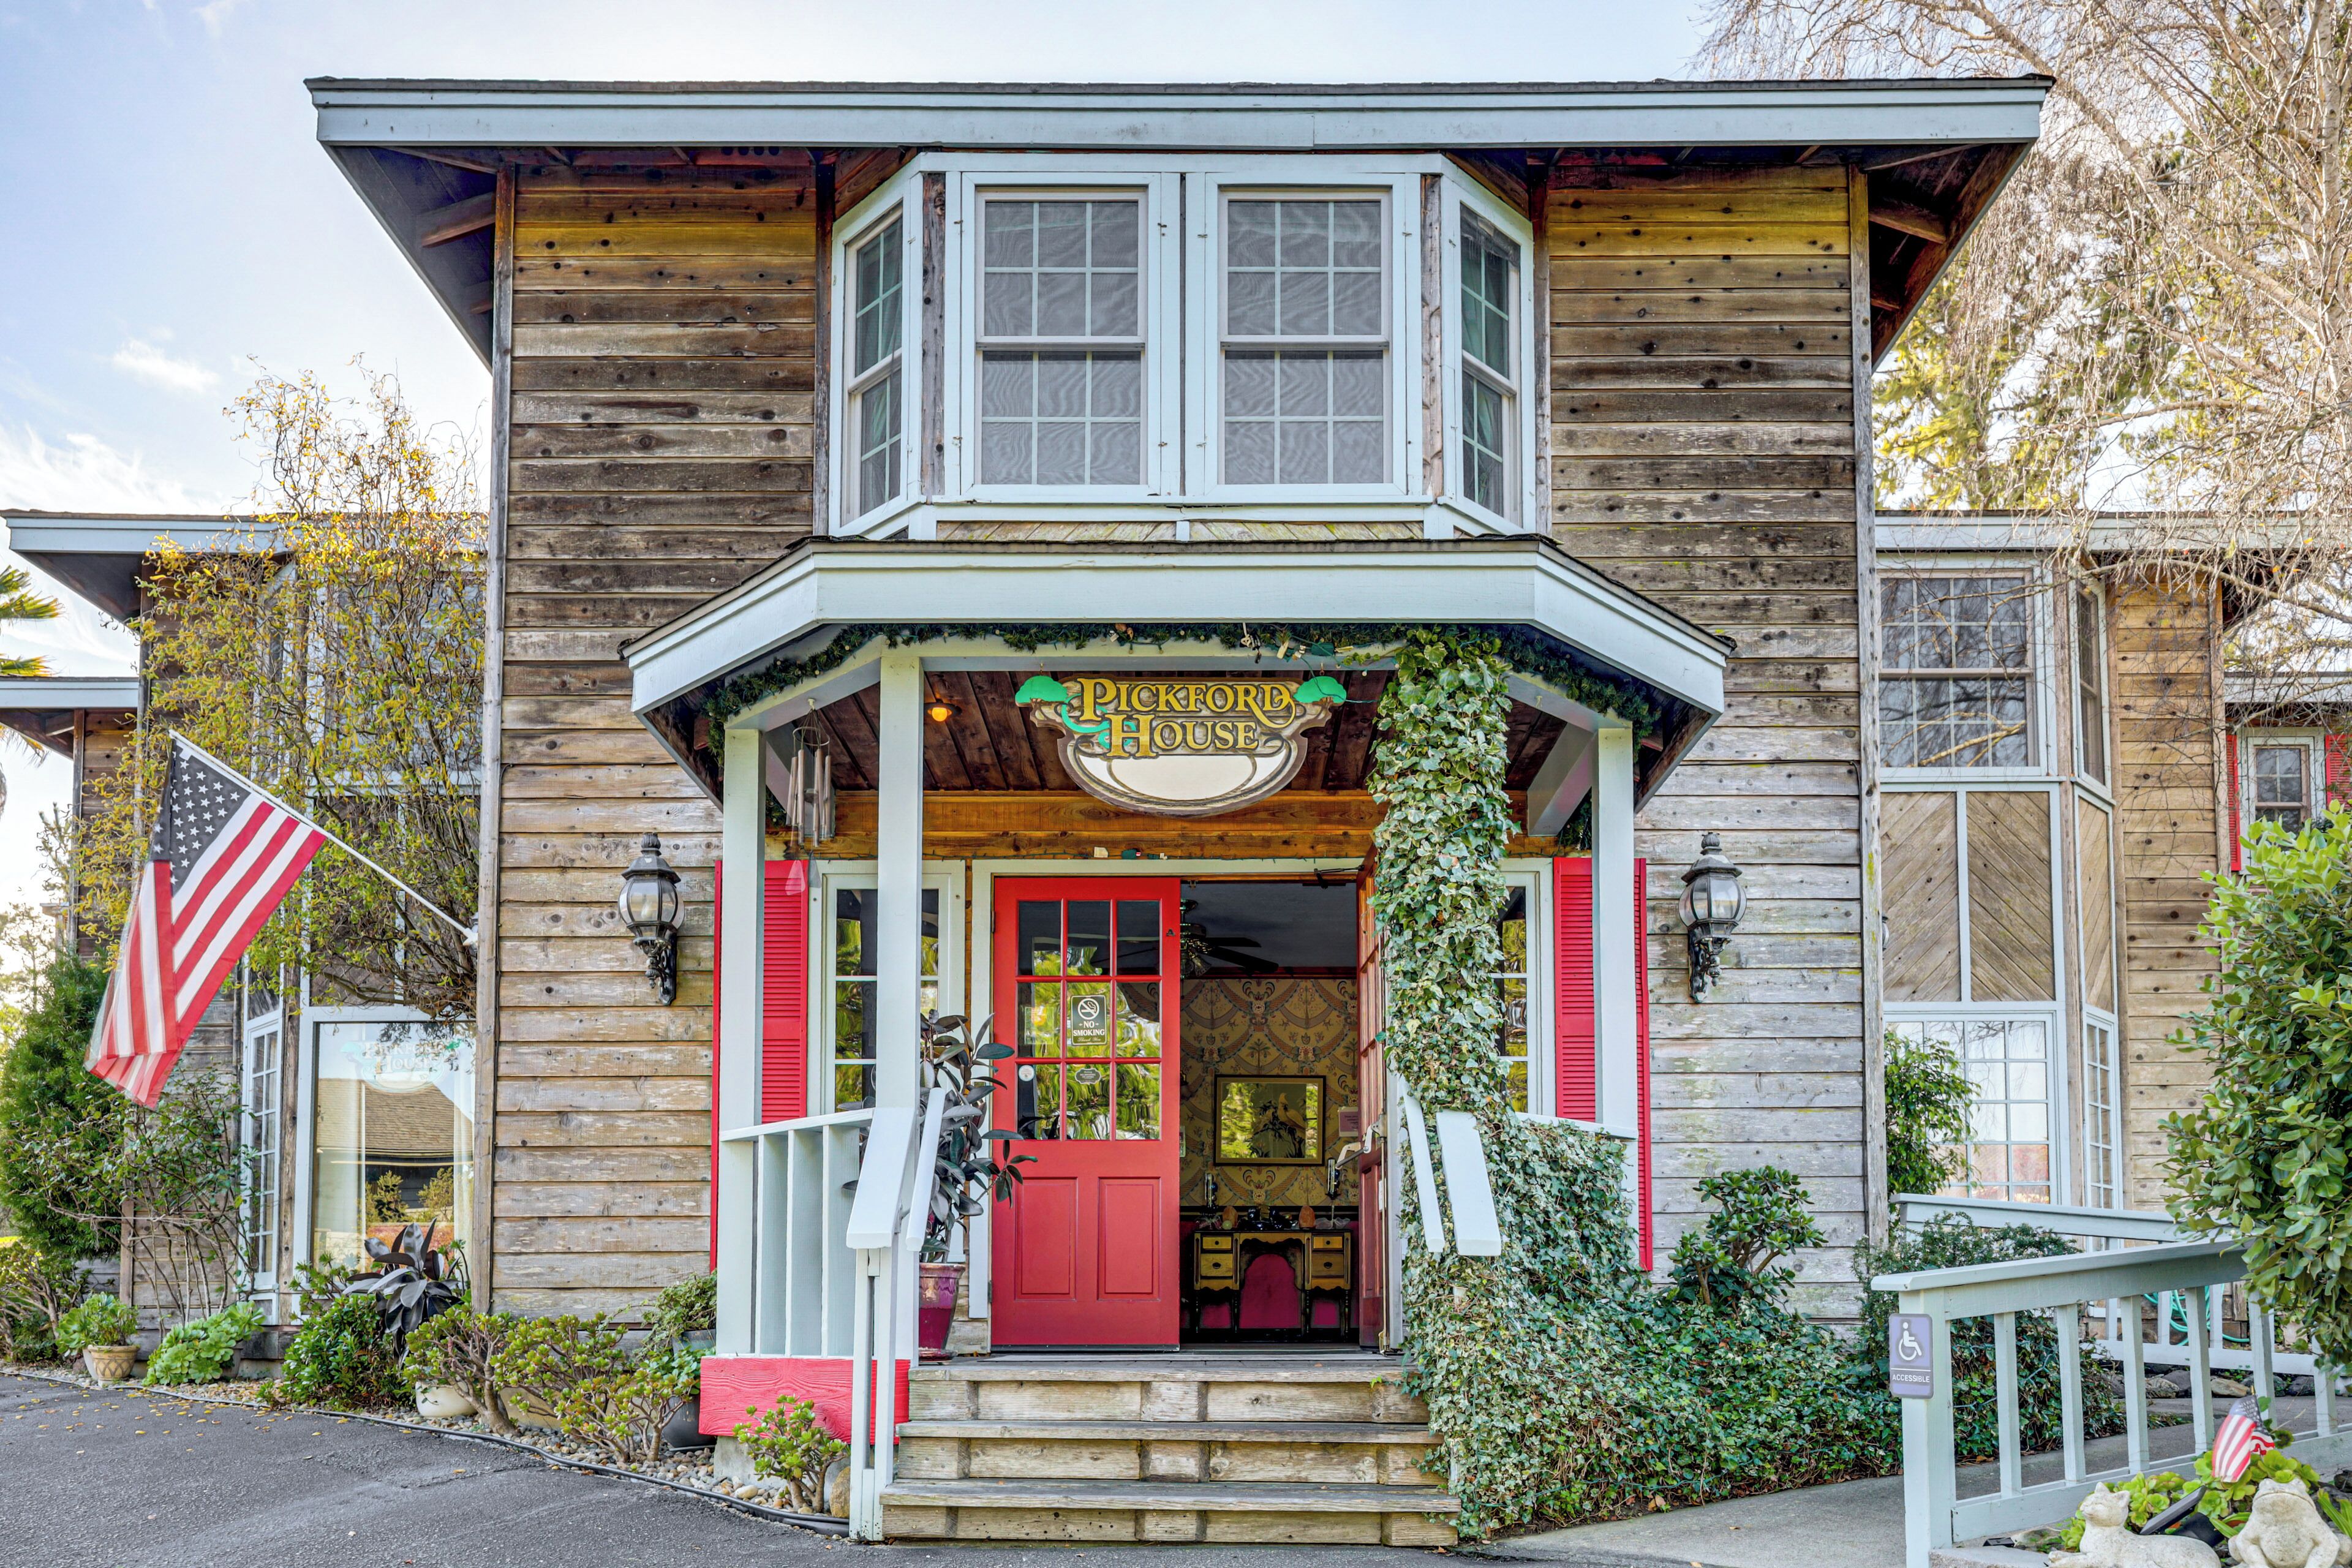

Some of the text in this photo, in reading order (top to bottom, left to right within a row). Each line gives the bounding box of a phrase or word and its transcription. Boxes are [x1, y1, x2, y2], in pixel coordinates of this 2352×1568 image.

[1077, 677, 1295, 728] PICKFORD
[1106, 714, 1259, 757] HOUSE
[1892, 1374, 1930, 1382] ACCESSIBLE
